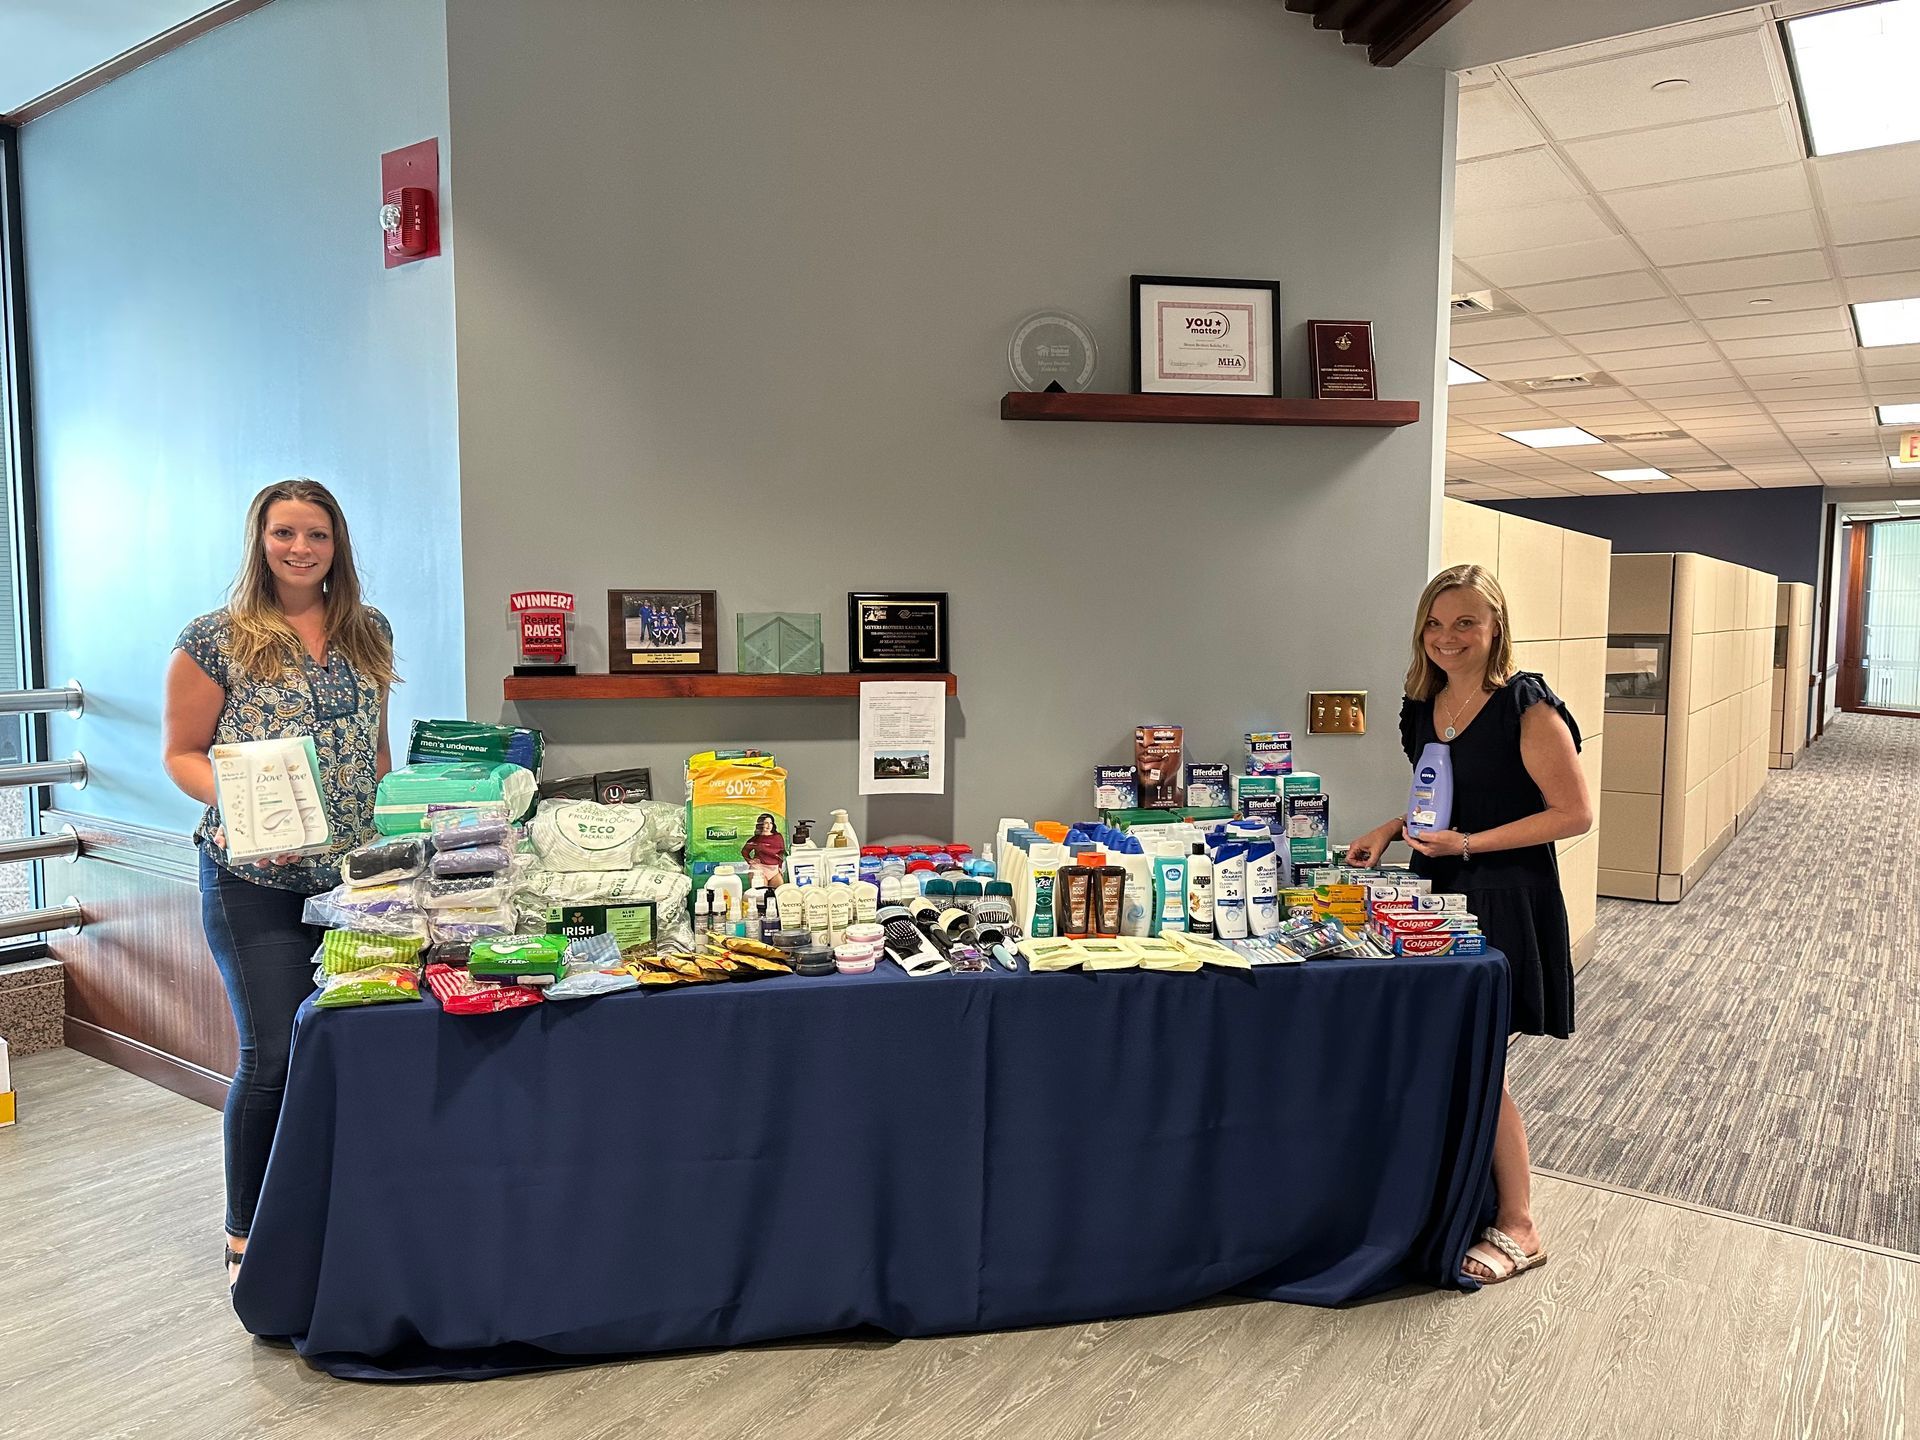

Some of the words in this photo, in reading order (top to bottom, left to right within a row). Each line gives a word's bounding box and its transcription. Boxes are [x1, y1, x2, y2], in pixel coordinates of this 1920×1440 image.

[1185, 317, 1213, 329] you
[1190, 327, 1222, 335] matter
[1217, 357, 1242, 367] MHA
[512, 593, 572, 610] WINNER!
[524, 614, 561, 625] Reader
[524, 624, 562, 637] RAVES
[525, 637, 562, 645] 2023
[1153, 730, 1175, 738] Gillette
[420, 740, 445, 749] men's
[445, 742, 489, 753] underwear
[1255, 741, 1288, 751] Efferdent
[1101, 768, 1132, 778] Efferdent
[1192, 767, 1223, 776] Efferdent
[256, 773, 283, 783] Dove
[709, 780, 725, 788] OVER
[725, 779, 756, 796] 60%
[609, 787, 619, 799] U
[1248, 800, 1277, 809] Efferdent
[1294, 798, 1324, 808] Efferdent
[589, 825, 616, 834] ECO
[708, 829, 736, 838] Depend
[1037, 878, 1052, 888] Zest
[1375, 889, 1394, 898] Crest
[1373, 902, 1414, 910] Colgate
[1422, 899, 1440, 908] Crest
[1396, 920, 1434, 930] Colgate
[562, 925, 595, 936] IRISH
[1404, 939, 1443, 949] Colgate
